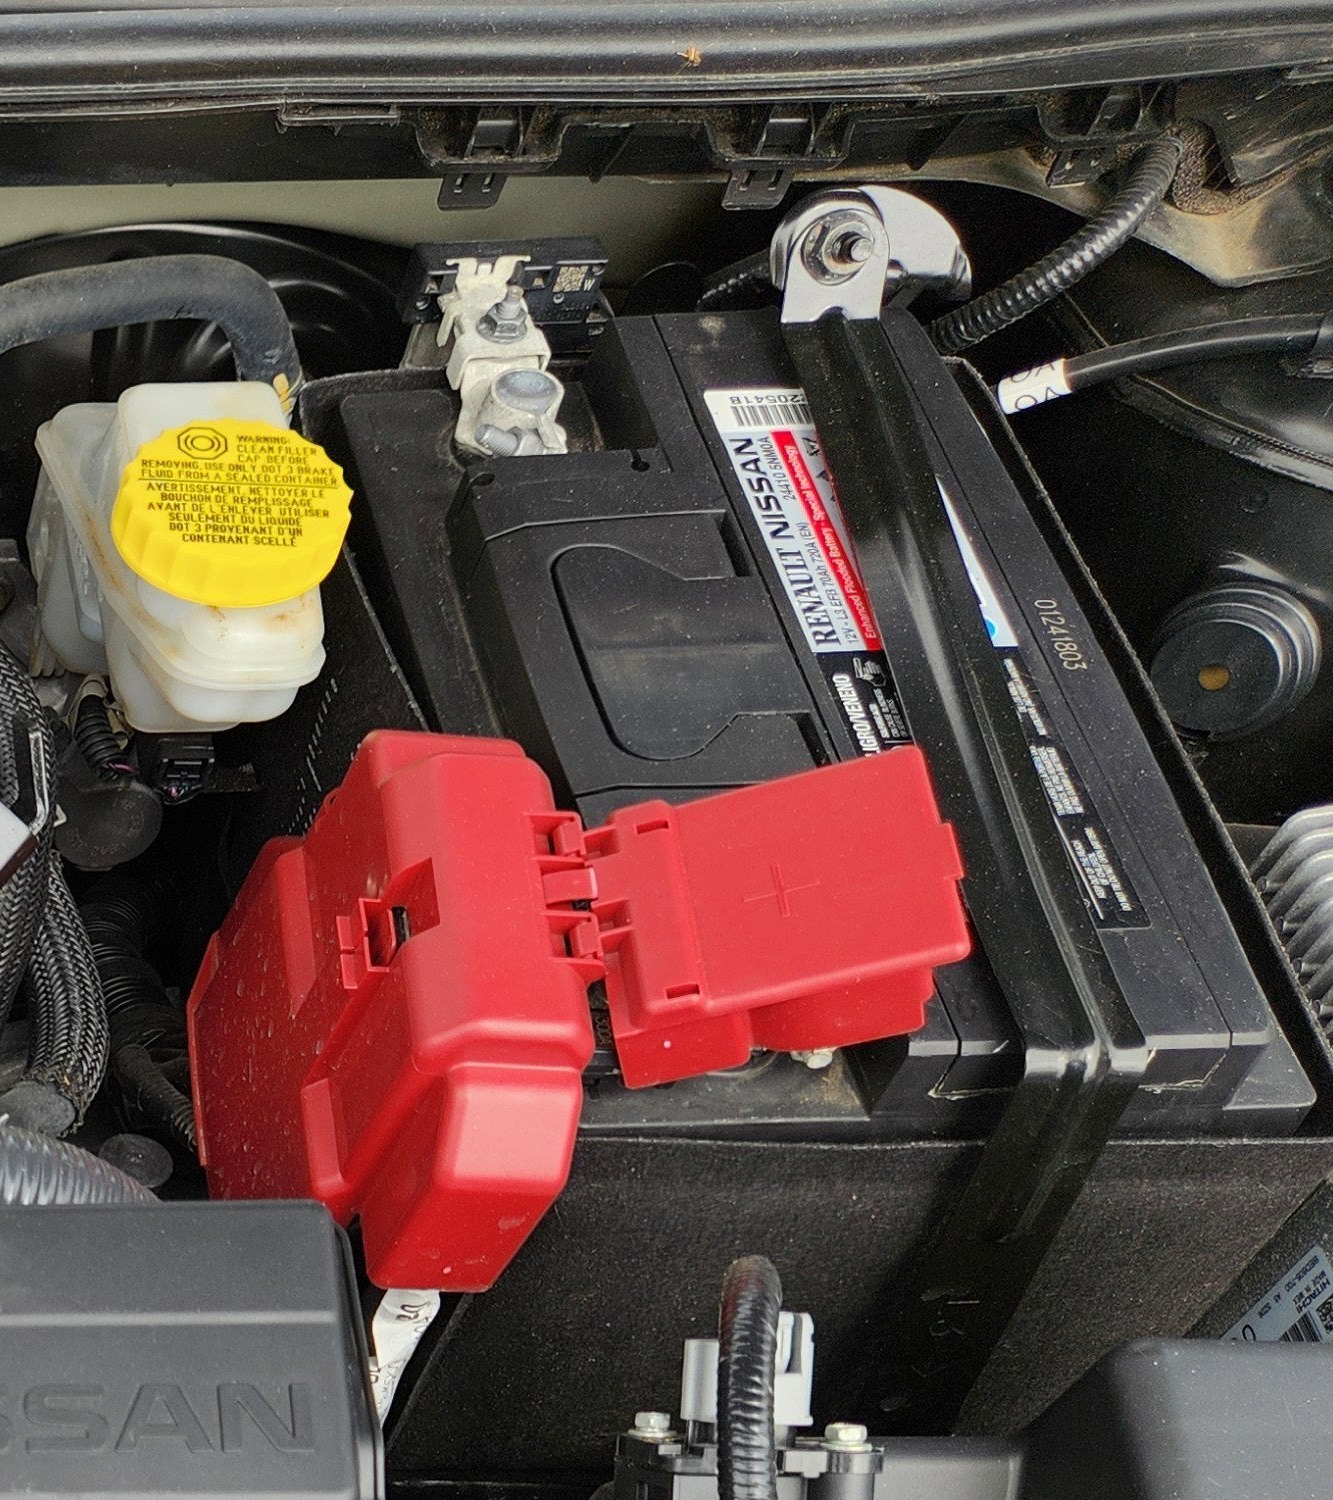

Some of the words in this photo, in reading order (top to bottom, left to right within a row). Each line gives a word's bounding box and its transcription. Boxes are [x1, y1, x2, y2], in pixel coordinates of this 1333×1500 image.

[236, 445, 275, 454] CLEAN
[278, 447, 317, 456] FILLER
[238, 454, 261, 463] CAP
[266, 456, 308, 465] BEFORE
[141, 469, 173, 479] FLUID
[178, 470, 209, 480] FROM
[215, 471, 222, 481] A
[227, 472, 271, 483] SEALED
[274, 474, 338, 486] CONTAINER
[205, 462, 223, 471] USE
[228, 463, 256, 473] ONLY
[262, 464, 282, 474] DOT
[297, 466, 334, 476] BRAKE
[249, 486, 308, 498] NETTOYER
[311, 489, 324, 498] LE
[729, 438, 794, 540] NISSAN
[777, 472, 796, 501] 24410
[161, 492, 211, 502] BOUCHON
[215, 494, 227, 503] DE
[233, 494, 312, 507] REMPLISSAGE
[802, 491, 825, 522] Special
[147, 501, 187, 512] AVANT
[192, 503, 207, 513] DE
[279, 507, 329, 518] UTILISER
[169, 512, 235, 524] SEULEMENT
[241, 515, 255, 524] DU
[258, 516, 302, 527] LIQUIDE
[169, 522, 191, 532] DOT
[205, 523, 273, 535] PROVENANT
[182, 532, 249, 545] CONTENANT
[822, 527, 841, 558] Battery
[833, 558, 858, 598] Flooded
[776, 547, 841, 646] RENAULT
[851, 597, 876, 639] Enhanced
[1034, 599, 1088, 671] 01241803
[1296, 1278, 1331, 1314] HITACHI
